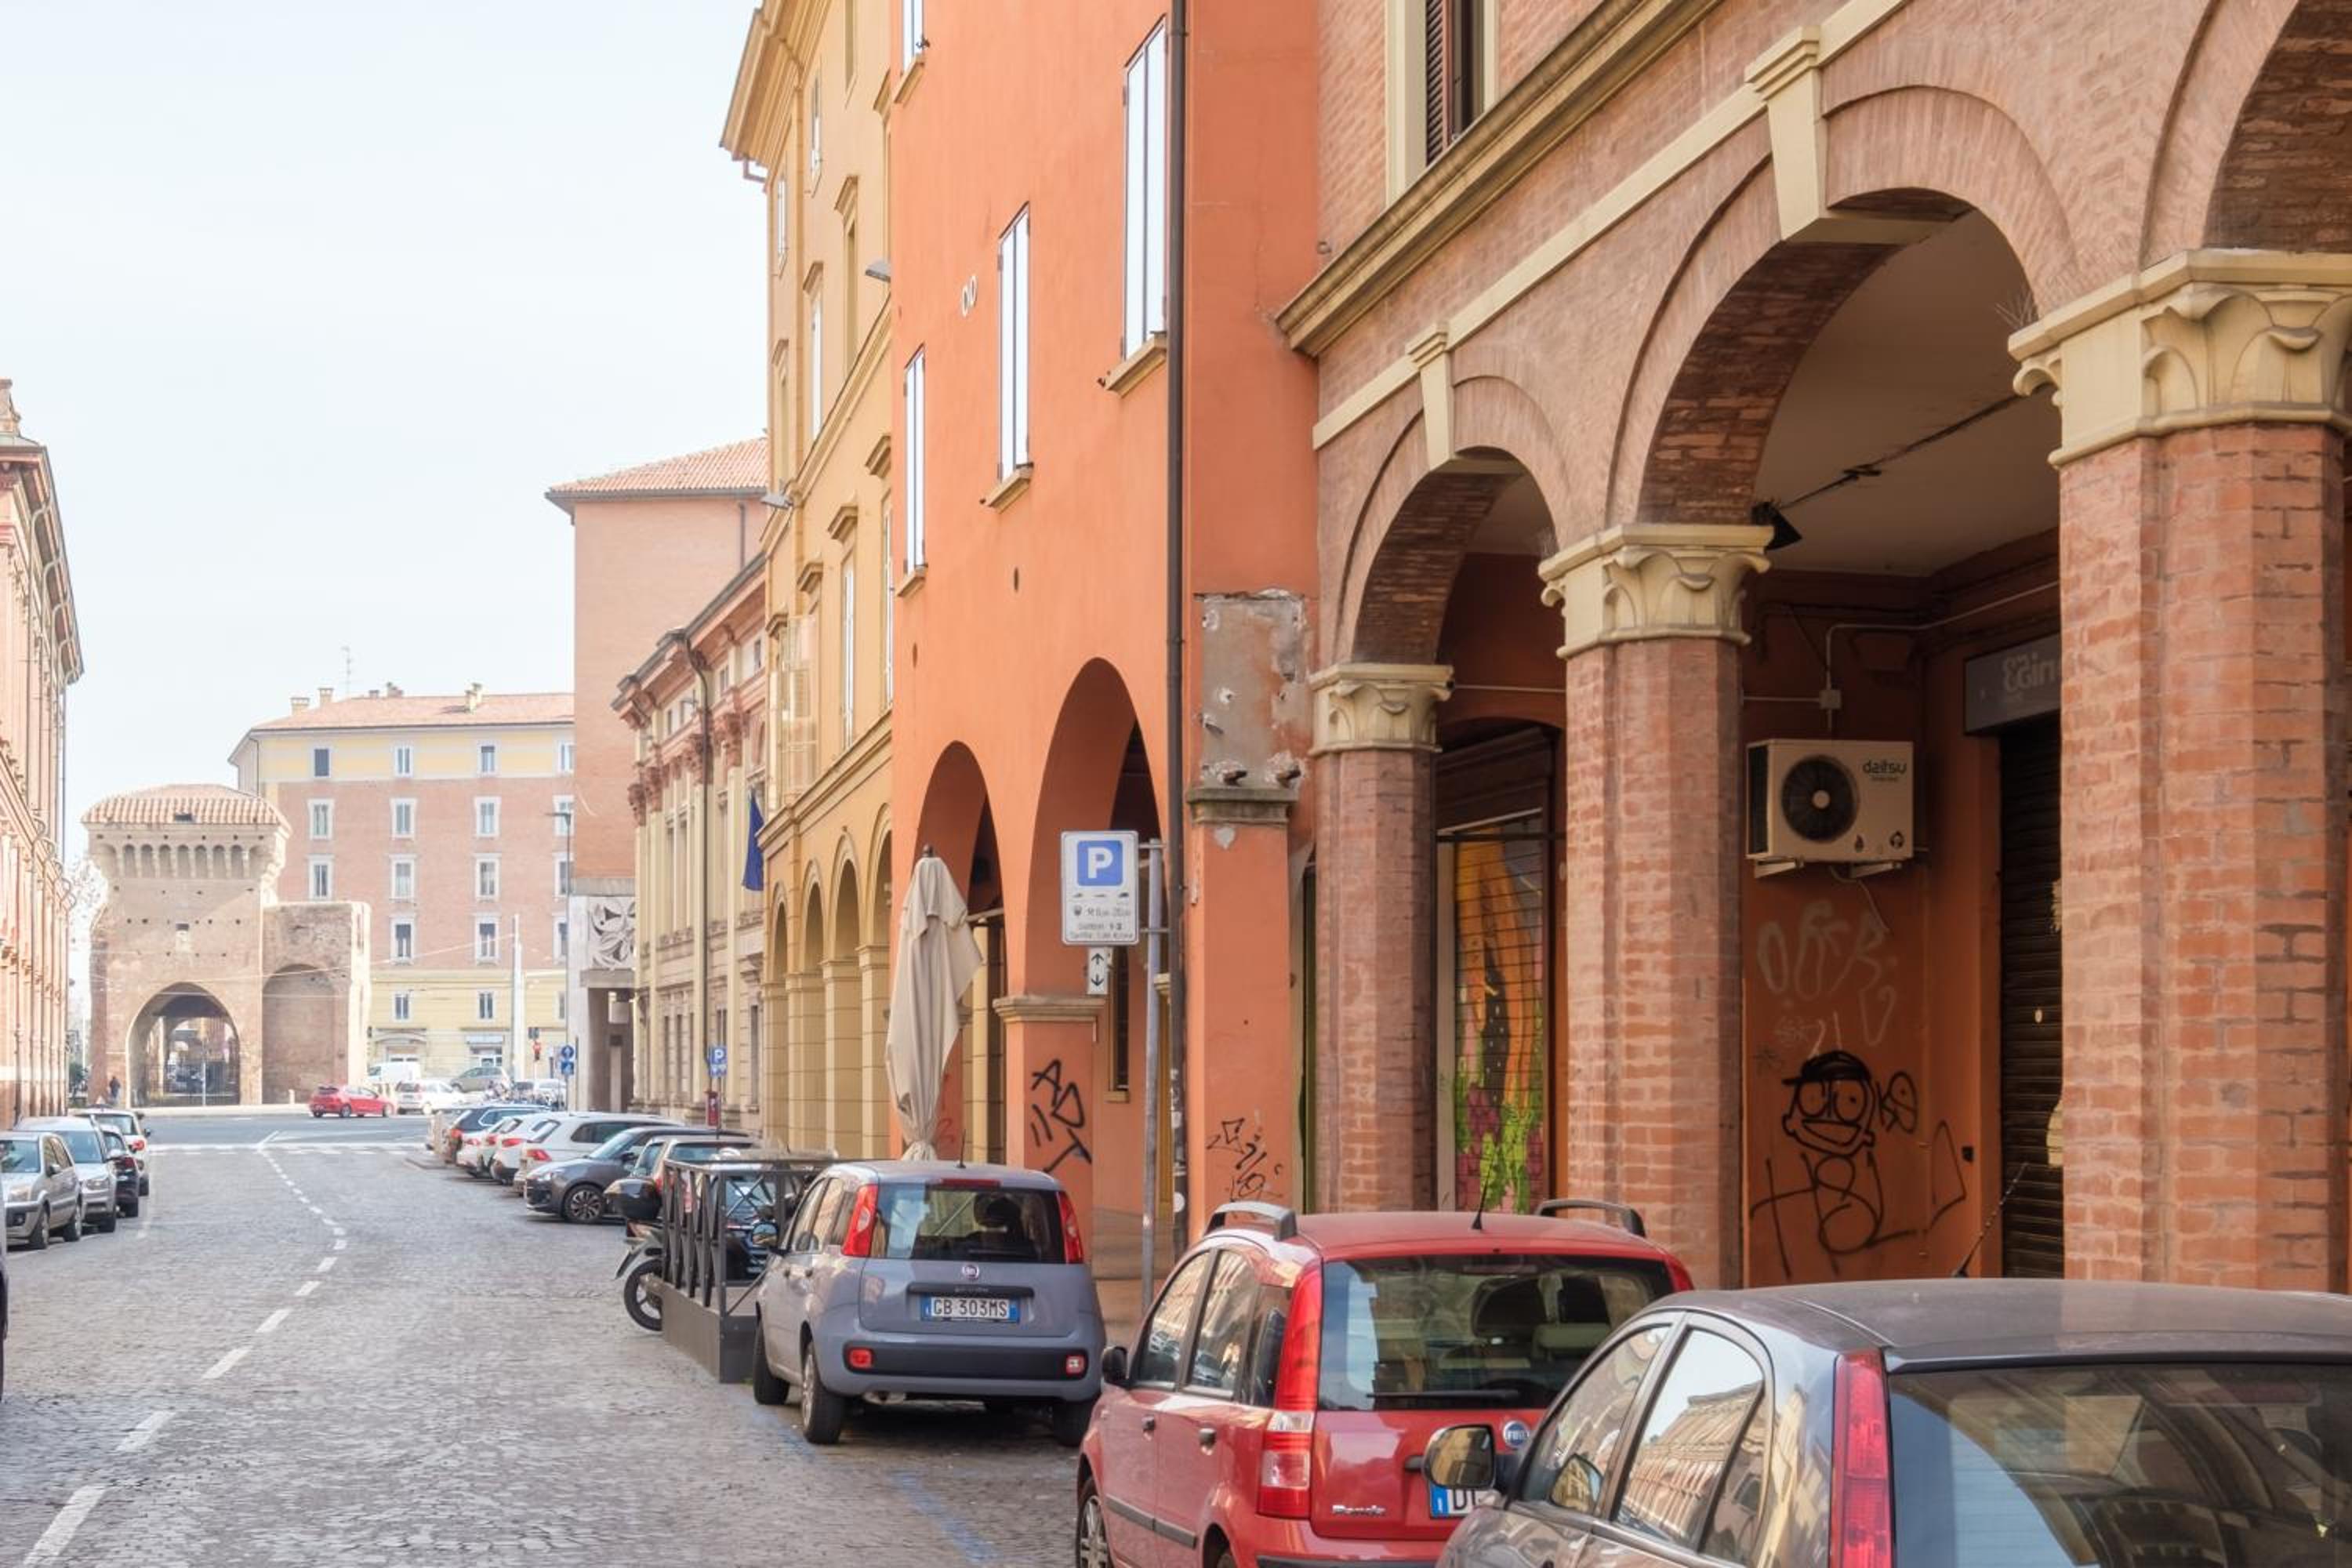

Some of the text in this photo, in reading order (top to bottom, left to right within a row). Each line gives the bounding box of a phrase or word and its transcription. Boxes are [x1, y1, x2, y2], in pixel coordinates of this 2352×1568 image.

[1087, 847, 1113, 879] P
[714, 1049, 724, 1062] P
[934, 1299, 1007, 1317] GB 303MS
